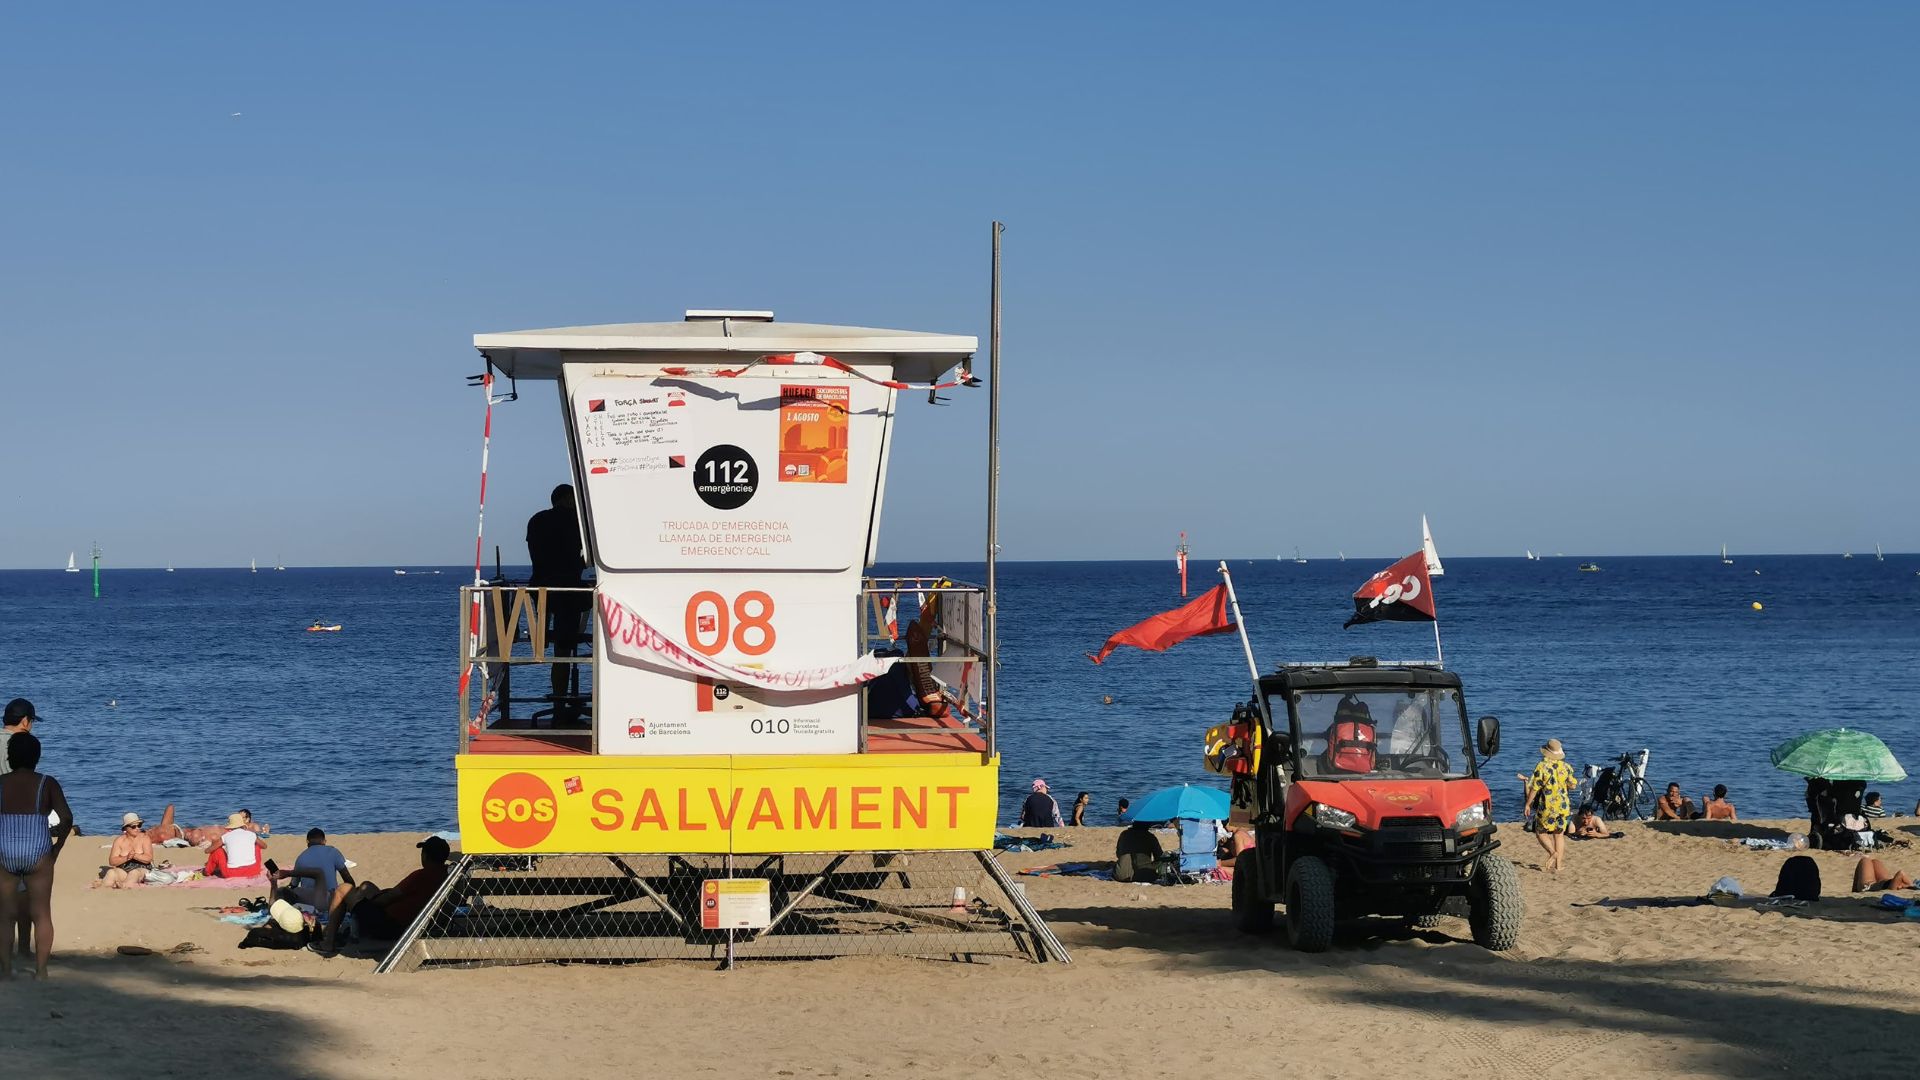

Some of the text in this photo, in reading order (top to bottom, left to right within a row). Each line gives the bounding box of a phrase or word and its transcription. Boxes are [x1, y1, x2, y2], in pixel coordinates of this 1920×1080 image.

[783, 388, 816, 398] HUELGA
[614, 398, 637, 406] FORÇA
[787, 412, 820, 422] 1 AGOSTO
[705, 460, 749, 483] 112
[699, 484, 753, 495] emergències
[663, 520, 789, 531] TRUCADA D'EMERGÈNCIA
[659, 534, 792, 543] LLAMADA DE EMERGENCIA
[681, 546, 770, 556] EMERGENCY CALL
[685, 590, 776, 656] 08
[751, 718, 790, 734] 010
[485, 797, 554, 823] SOS
[590, 786, 970, 832] SALVAMENT
